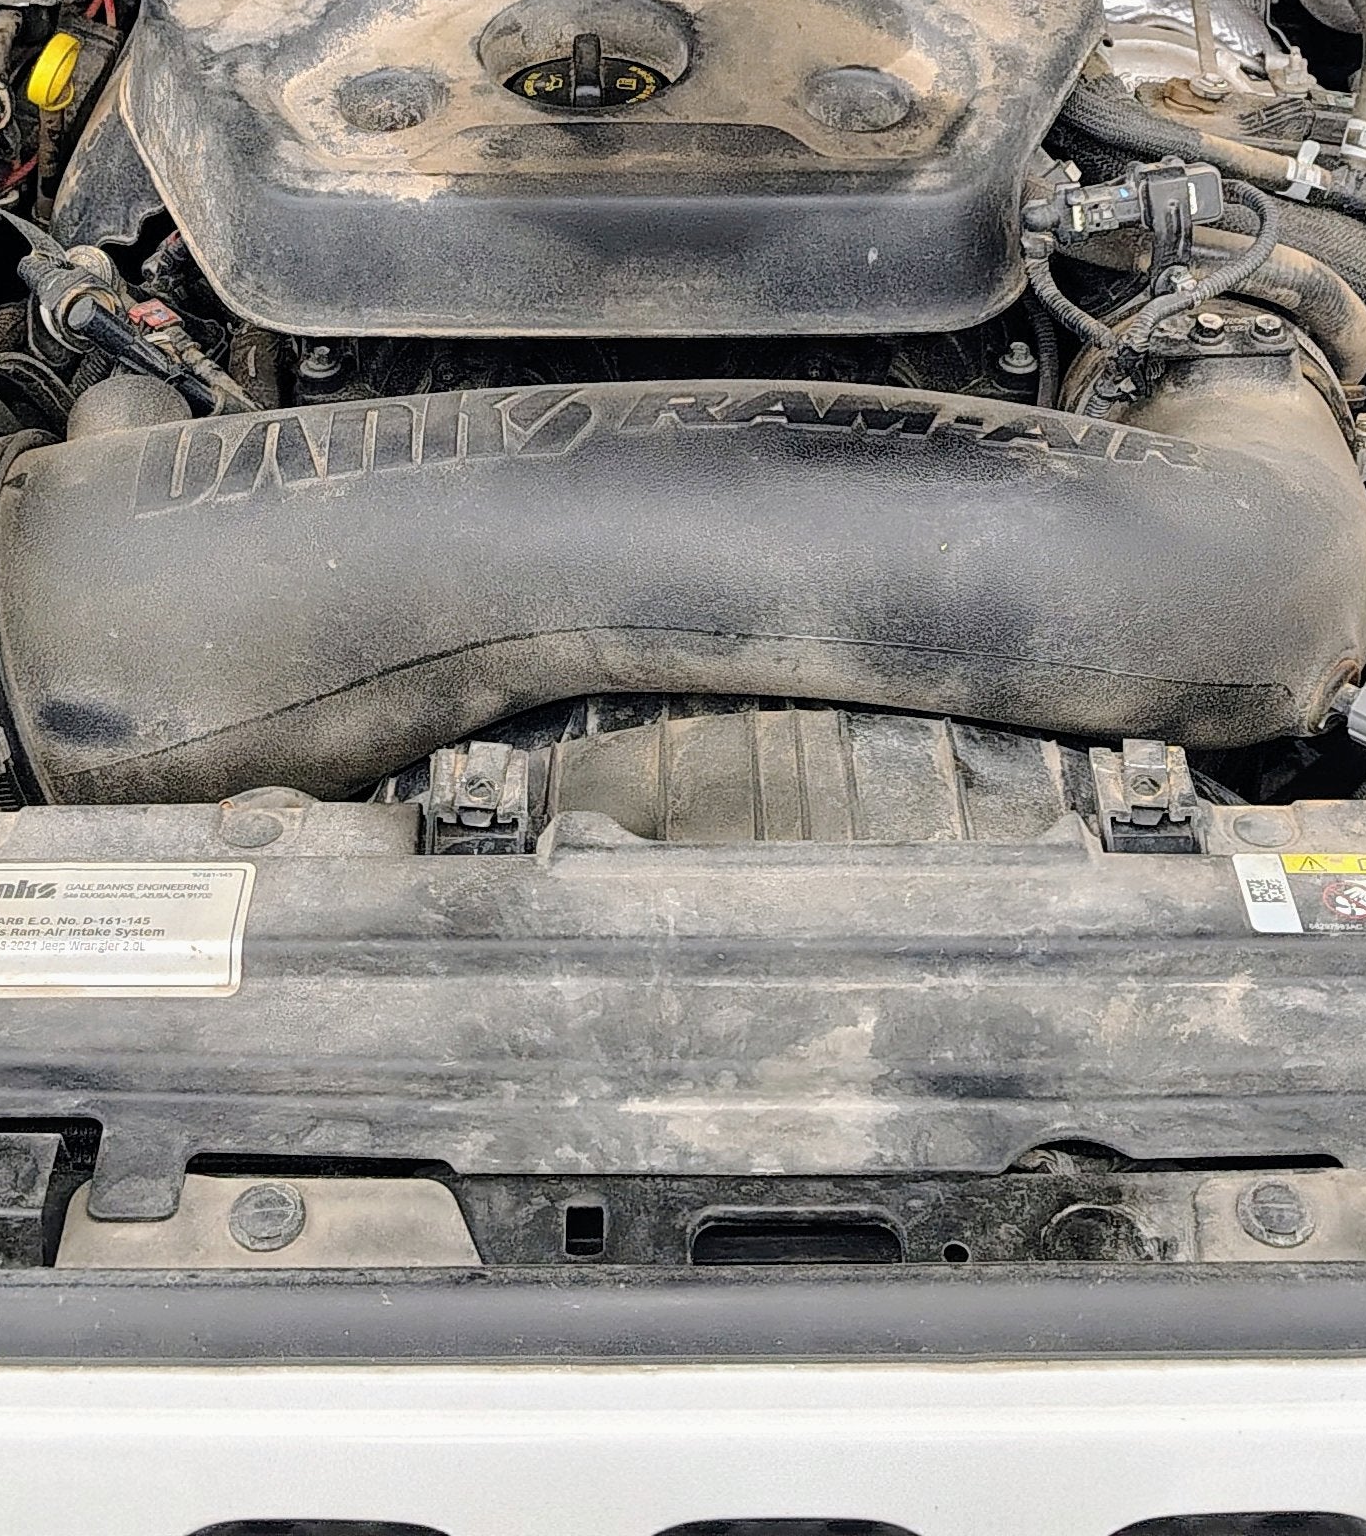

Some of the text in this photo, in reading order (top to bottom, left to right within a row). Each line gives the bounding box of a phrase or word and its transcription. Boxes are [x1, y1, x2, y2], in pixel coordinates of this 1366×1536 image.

[65, 883, 210, 892] GALE BANKS ENGINEERING
[28, 916, 53, 926] E.O.
[57, 916, 79, 926] No.
[83, 916, 151, 926] D-161-145
[10, 928, 65, 937] Ram-Air
[68, 928, 111, 937] Intake
[114, 928, 166, 939] System
[40, 941, 67, 953] Jeep
[69, 941, 121, 953] Wrangler
